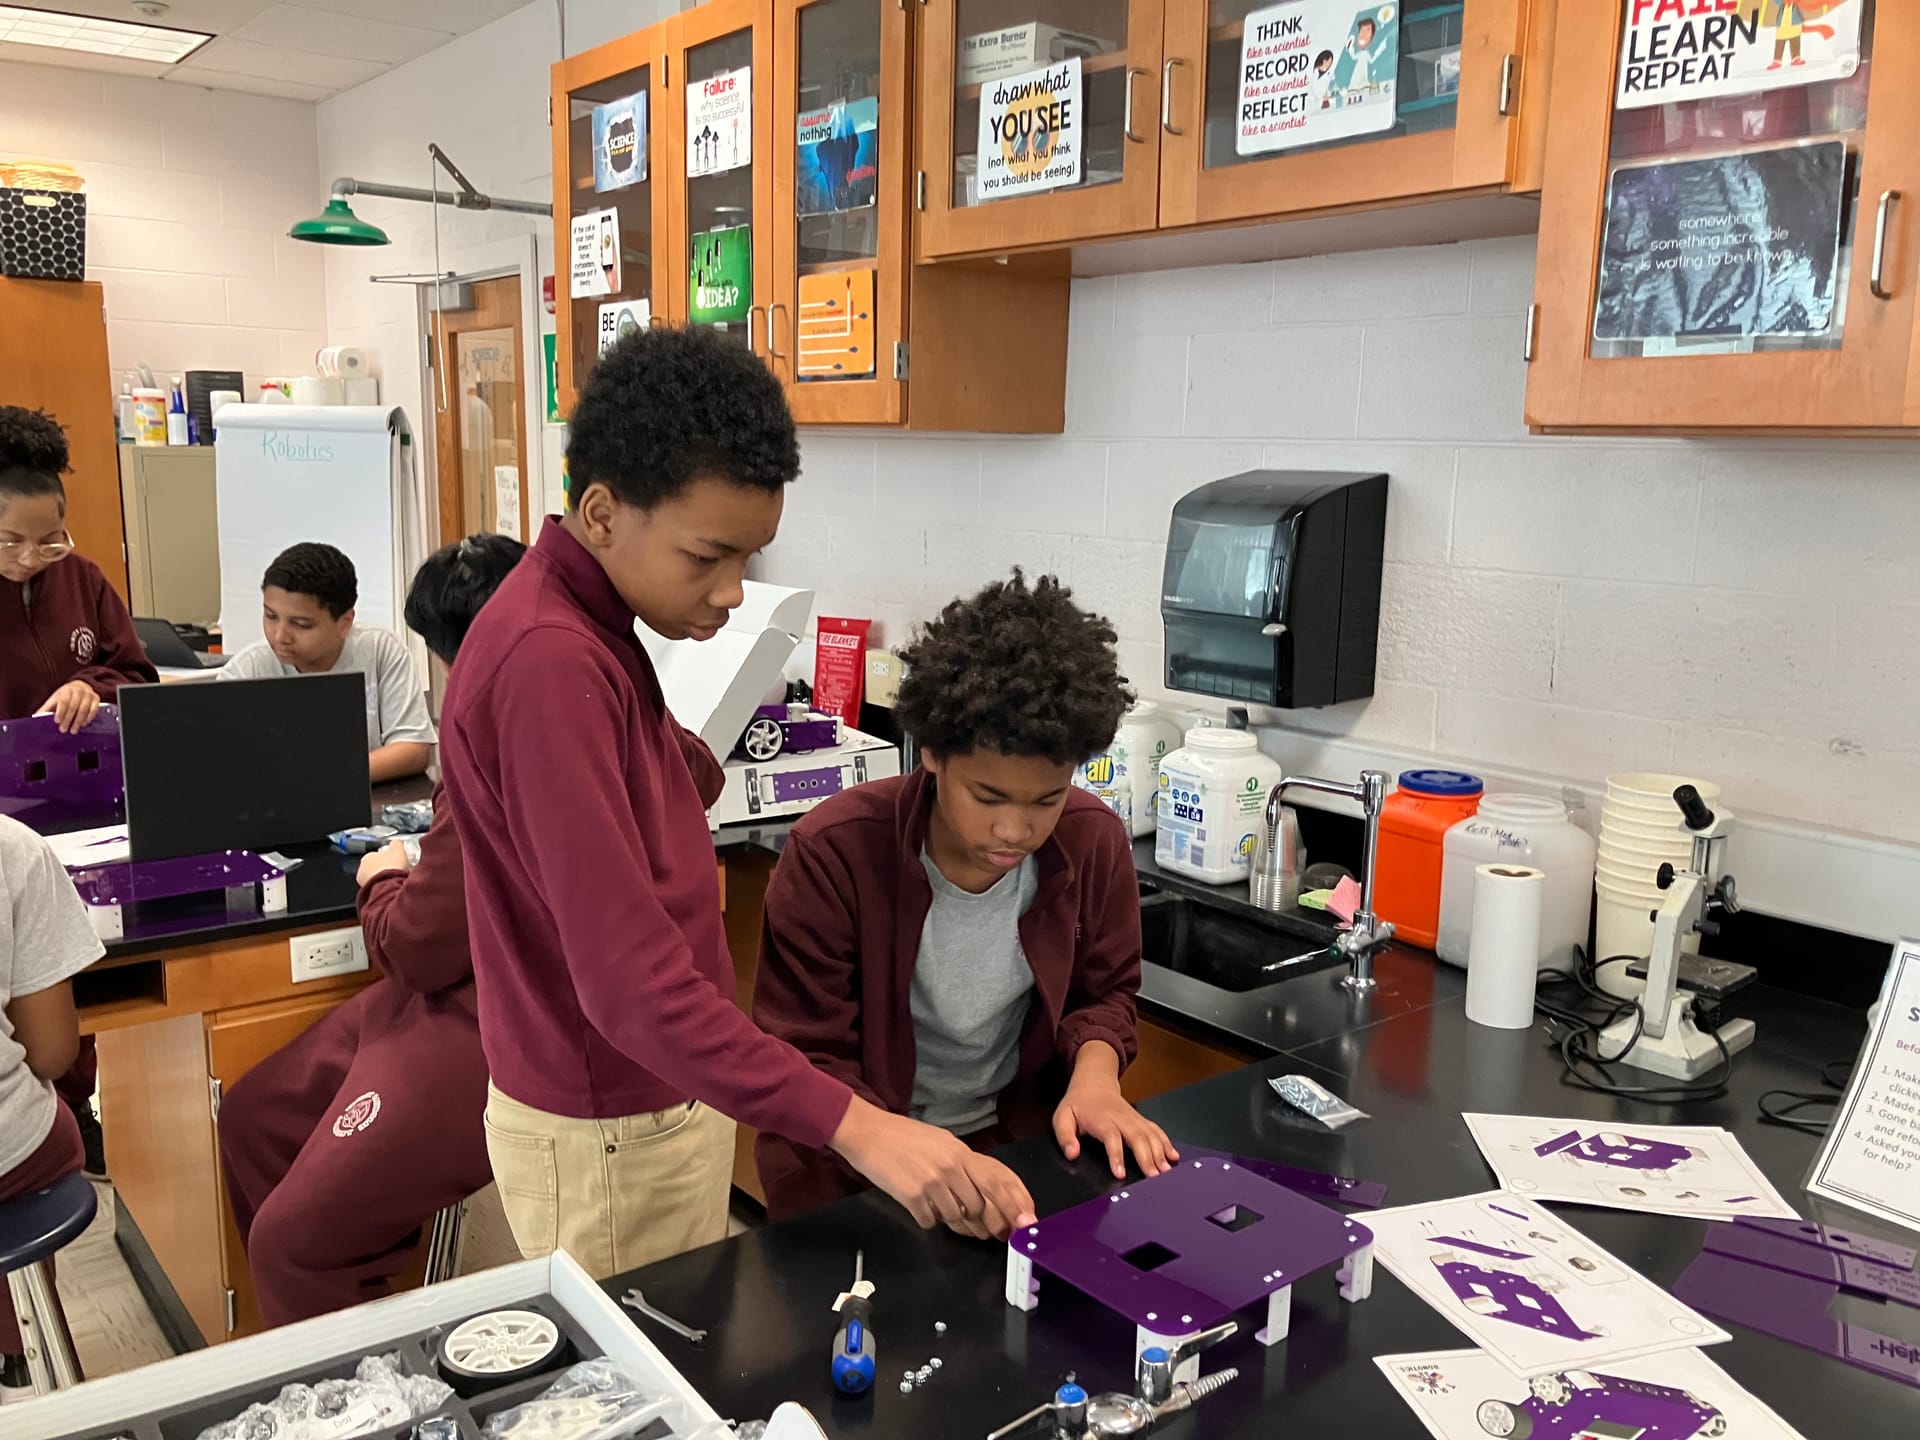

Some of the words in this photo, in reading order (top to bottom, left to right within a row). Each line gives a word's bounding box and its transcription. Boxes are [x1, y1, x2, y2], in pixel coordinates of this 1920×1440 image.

[1632, 0, 1738, 26] FA
[1257, 16, 1303, 42] THINK
[1628, 8, 1759, 65] LEARN
[964, 40, 976, 51] The
[979, 36, 998, 48] Extra
[1001, 31, 1027, 44] Burner
[1246, 46, 1262, 59] like
[1265, 46, 1271, 55] a
[1273, 33, 1311, 54] scientist
[1245, 53, 1309, 83] RECORD
[1624, 51, 1736, 93] REPEAT
[704, 78, 736, 98] failure:
[993, 81, 1032, 105] draw
[1034, 64, 1071, 96] what
[1244, 85, 1260, 98] like
[1262, 85, 1269, 94] a
[1271, 74, 1308, 93] scientist
[701, 100, 713, 111] why
[715, 92, 740, 107] science
[703, 113, 711, 123] so
[712, 101, 744, 121] successful
[1242, 92, 1308, 122] REFLECT
[990, 109, 1032, 144] YOU
[1037, 99, 1071, 133] SEE
[1242, 123, 1258, 136] like
[1260, 124, 1266, 133] a
[1268, 115, 1306, 132] scientist
[609, 132, 634, 150] SCIENCE
[800, 126, 831, 142] nothing
[988, 155, 1005, 169] (not
[1008, 151, 1029, 165] what
[1033, 149, 1048, 164] you
[1051, 142, 1071, 157] think
[983, 181, 999, 191] you
[1001, 172, 1028, 186] should
[1031, 171, 1041, 181] be
[1044, 161, 1075, 179] seeing)
[1650, 233, 1721, 251] something
[1656, 252, 1702, 270] waiting
[1708, 252, 1721, 266] to
[1724, 251, 1743, 265] be
[705, 286, 739, 308] IDEA?
[602, 312, 615, 331] BE
[262, 431, 334, 463] Robotics
[831, 634, 858, 648] BLANKET
[1086, 755, 1113, 782] all
[1881, 1065, 1890, 1076] 1.
[1871, 1091, 1880, 1102] 2.
[1884, 1096, 1915, 1113] Made
[1889, 1083, 1920, 1100] clicke
[1865, 1104, 1874, 1114] 3.
[1879, 1109, 1907, 1126] Gone
[1854, 1130, 1863, 1141] 4.
[1866, 1135, 1899, 1153] Asked
[1874, 1124, 1895, 1136] and
[1897, 1132, 1920, 1146] refo
[1863, 1147, 1879, 1160] for
[1881, 1154, 1911, 1172] help?
